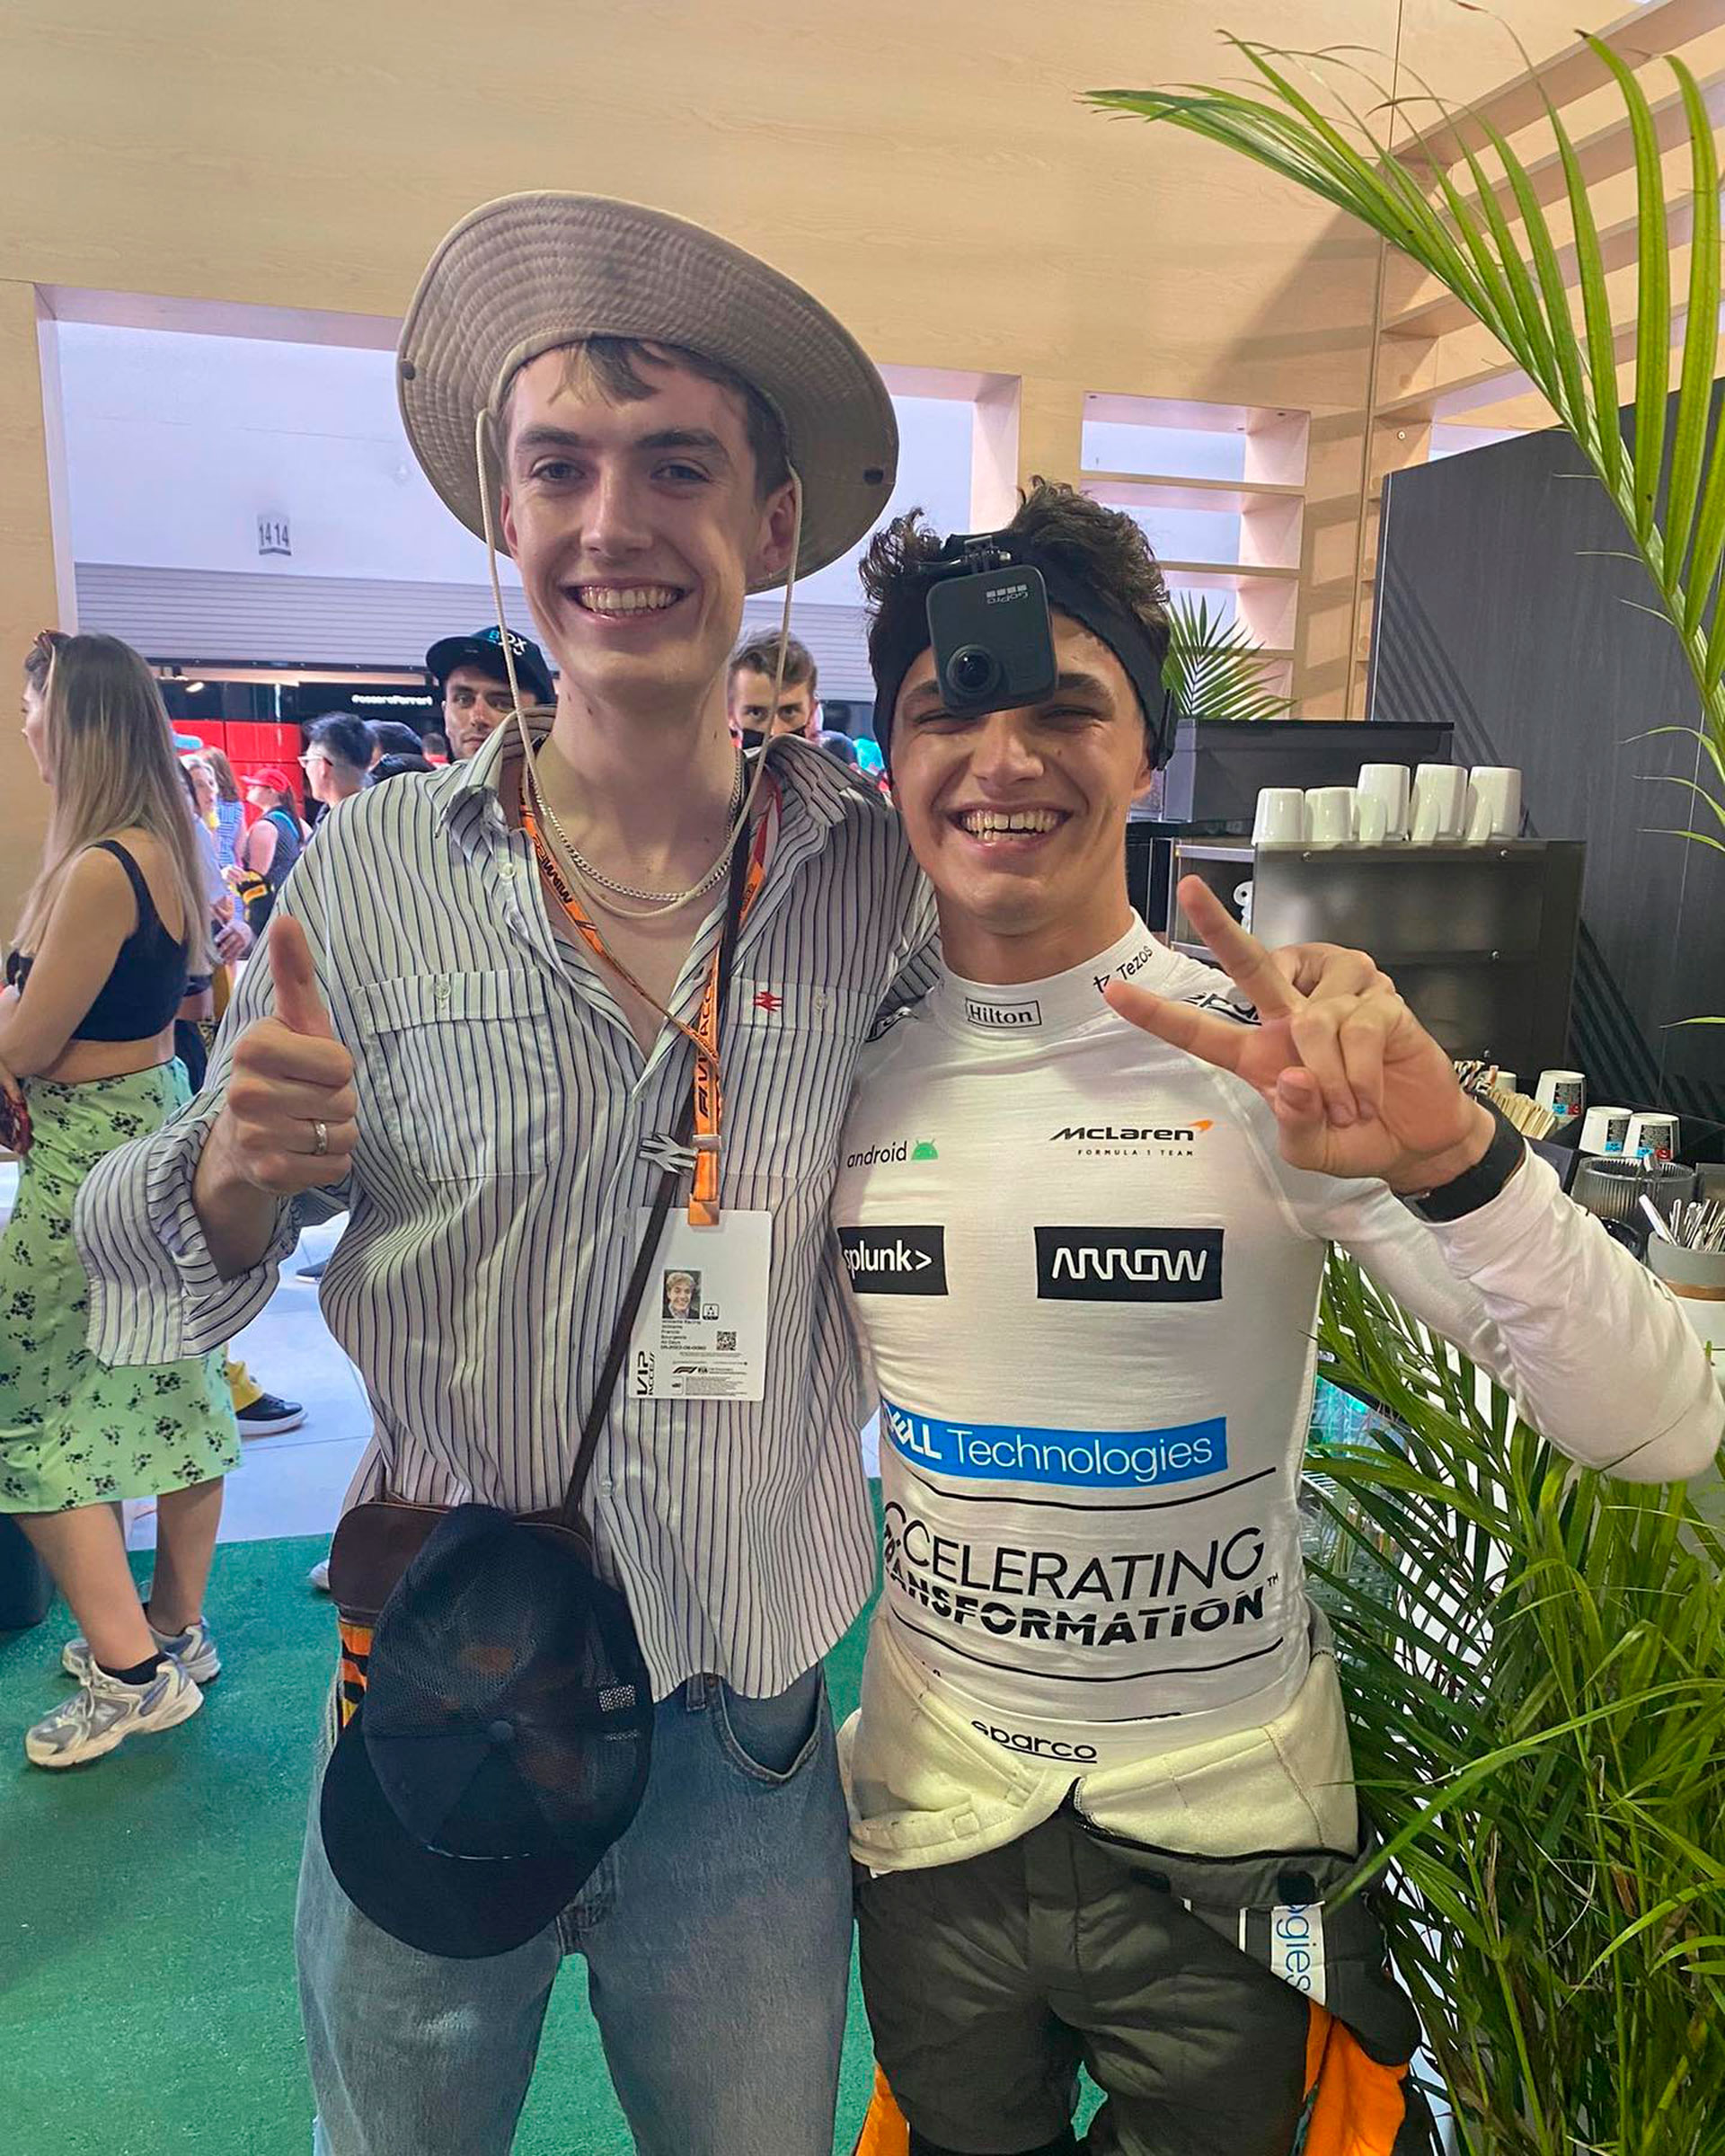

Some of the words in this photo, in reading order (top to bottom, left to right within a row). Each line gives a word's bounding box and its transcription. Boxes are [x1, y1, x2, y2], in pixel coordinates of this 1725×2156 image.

[986, 591, 1029, 605] GoPro
[1116, 945, 1154, 980] Tezos
[969, 1003, 1032, 1025] Hilton
[1049, 1127, 1194, 1141] McLaren
[847, 1140, 907, 1169] android
[1161, 1149, 1193, 1157] TEAM
[1051, 1246, 1208, 1282] ARROW
[637, 1350, 649, 1395] VIP
[947, 1427, 1213, 1482] Technologies
[971, 1719, 1098, 1760] sparco
